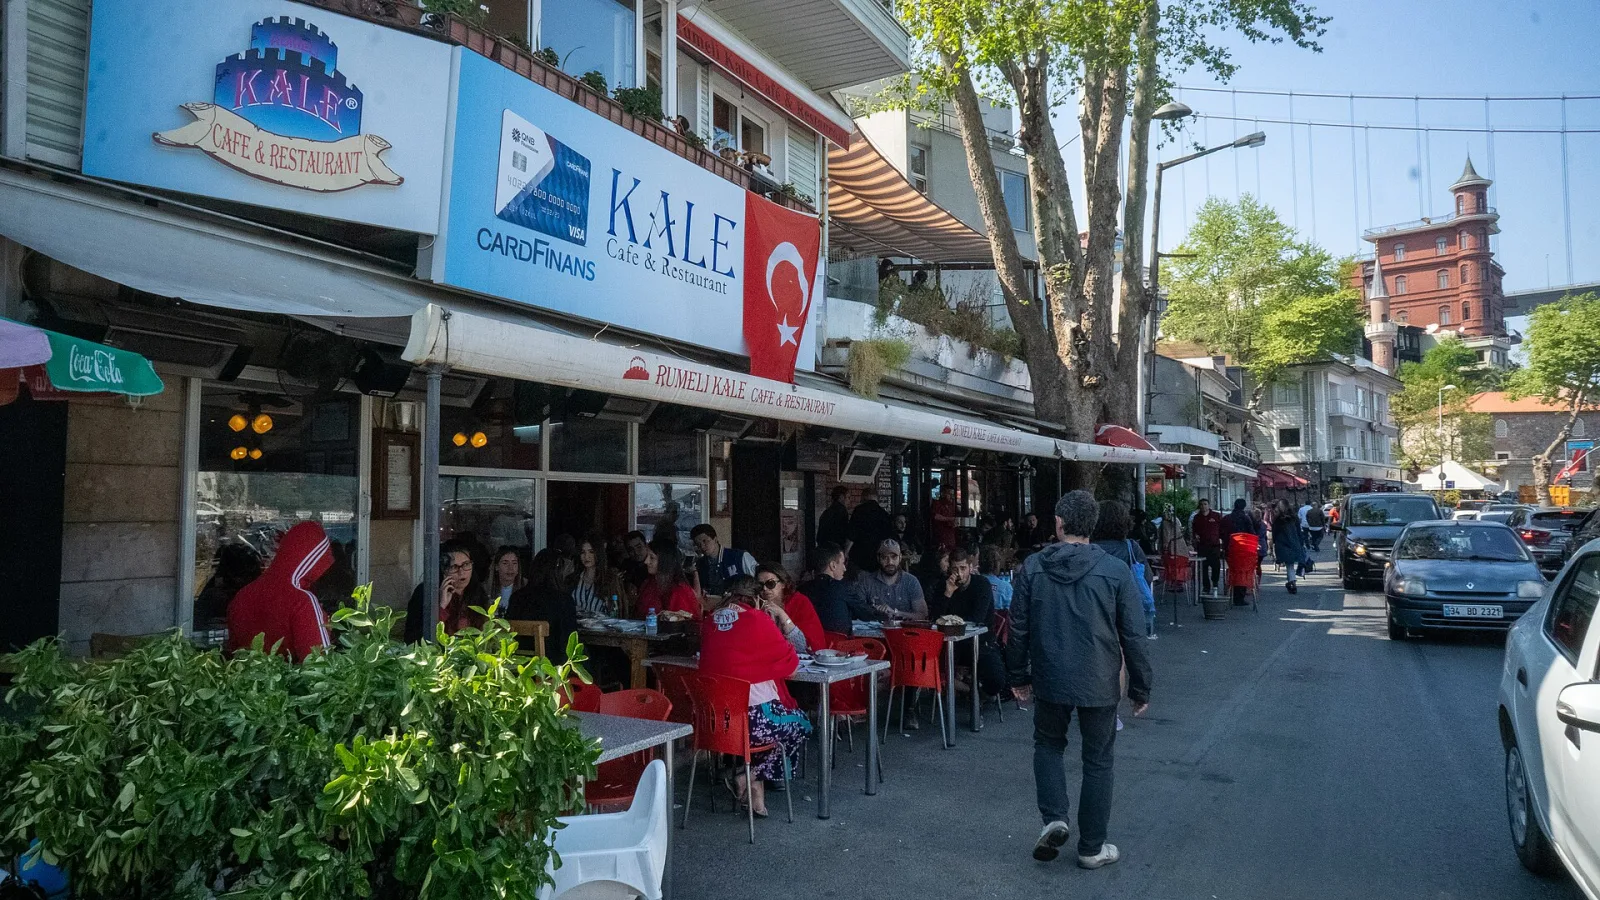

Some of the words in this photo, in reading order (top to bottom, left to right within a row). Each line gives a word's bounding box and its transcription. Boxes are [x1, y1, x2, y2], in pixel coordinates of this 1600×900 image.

[724, 50, 752, 79] Kale
[232, 68, 343, 134] KALE
[212, 123, 251, 160] CAFE
[254, 140, 266, 165] &
[269, 143, 363, 176] RESTAURANT
[521, 132, 535, 146] QNB
[568, 224, 585, 241] VISA
[606, 168, 737, 279] KALE
[606, 238, 639, 266] Cafe
[644, 252, 656, 272] &
[662, 256, 728, 295] Restaurant
[655, 364, 710, 394] RUMELI
[712, 376, 747, 400] KALE
[750, 387, 776, 407] CAFE
[776, 392, 783, 407] &
[784, 394, 836, 416] RESTAURANT
[1450, 607, 1460, 616] 34
[1466, 607, 1477, 616] BD
